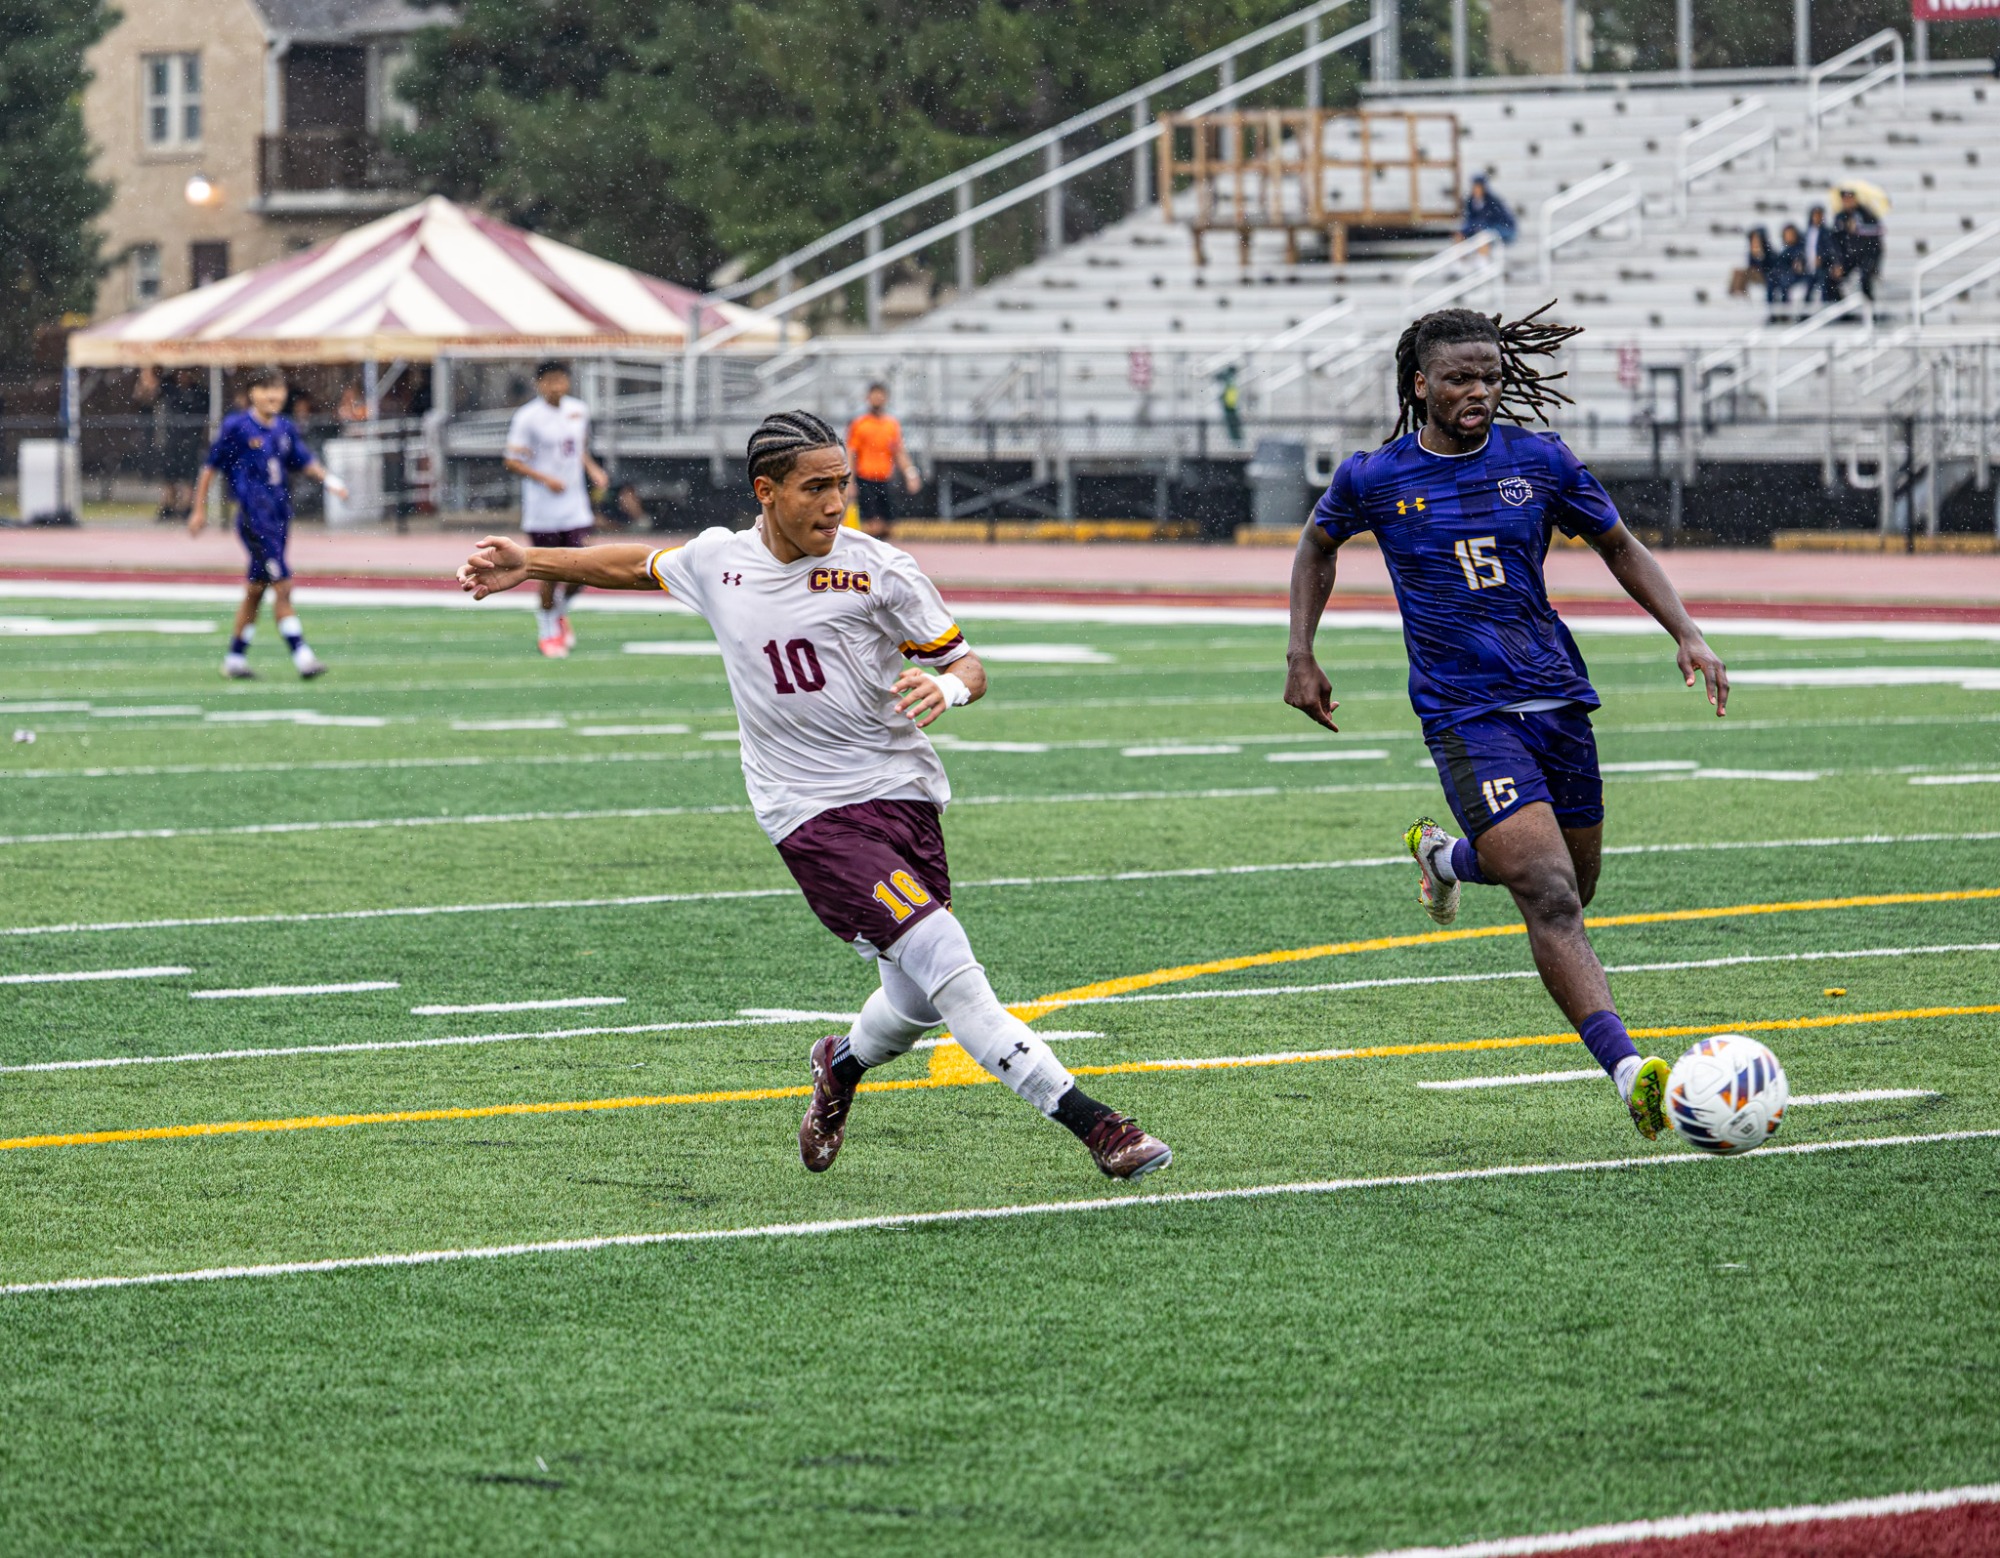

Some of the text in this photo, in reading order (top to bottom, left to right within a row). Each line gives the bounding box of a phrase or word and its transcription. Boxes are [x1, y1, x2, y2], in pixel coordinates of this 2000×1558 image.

[808, 568, 871, 594] CUC
[1454, 536, 1507, 590] 15
[762, 638, 827, 694] 10
[1482, 776, 1519, 815] 15
[872, 869, 931, 924] 10
